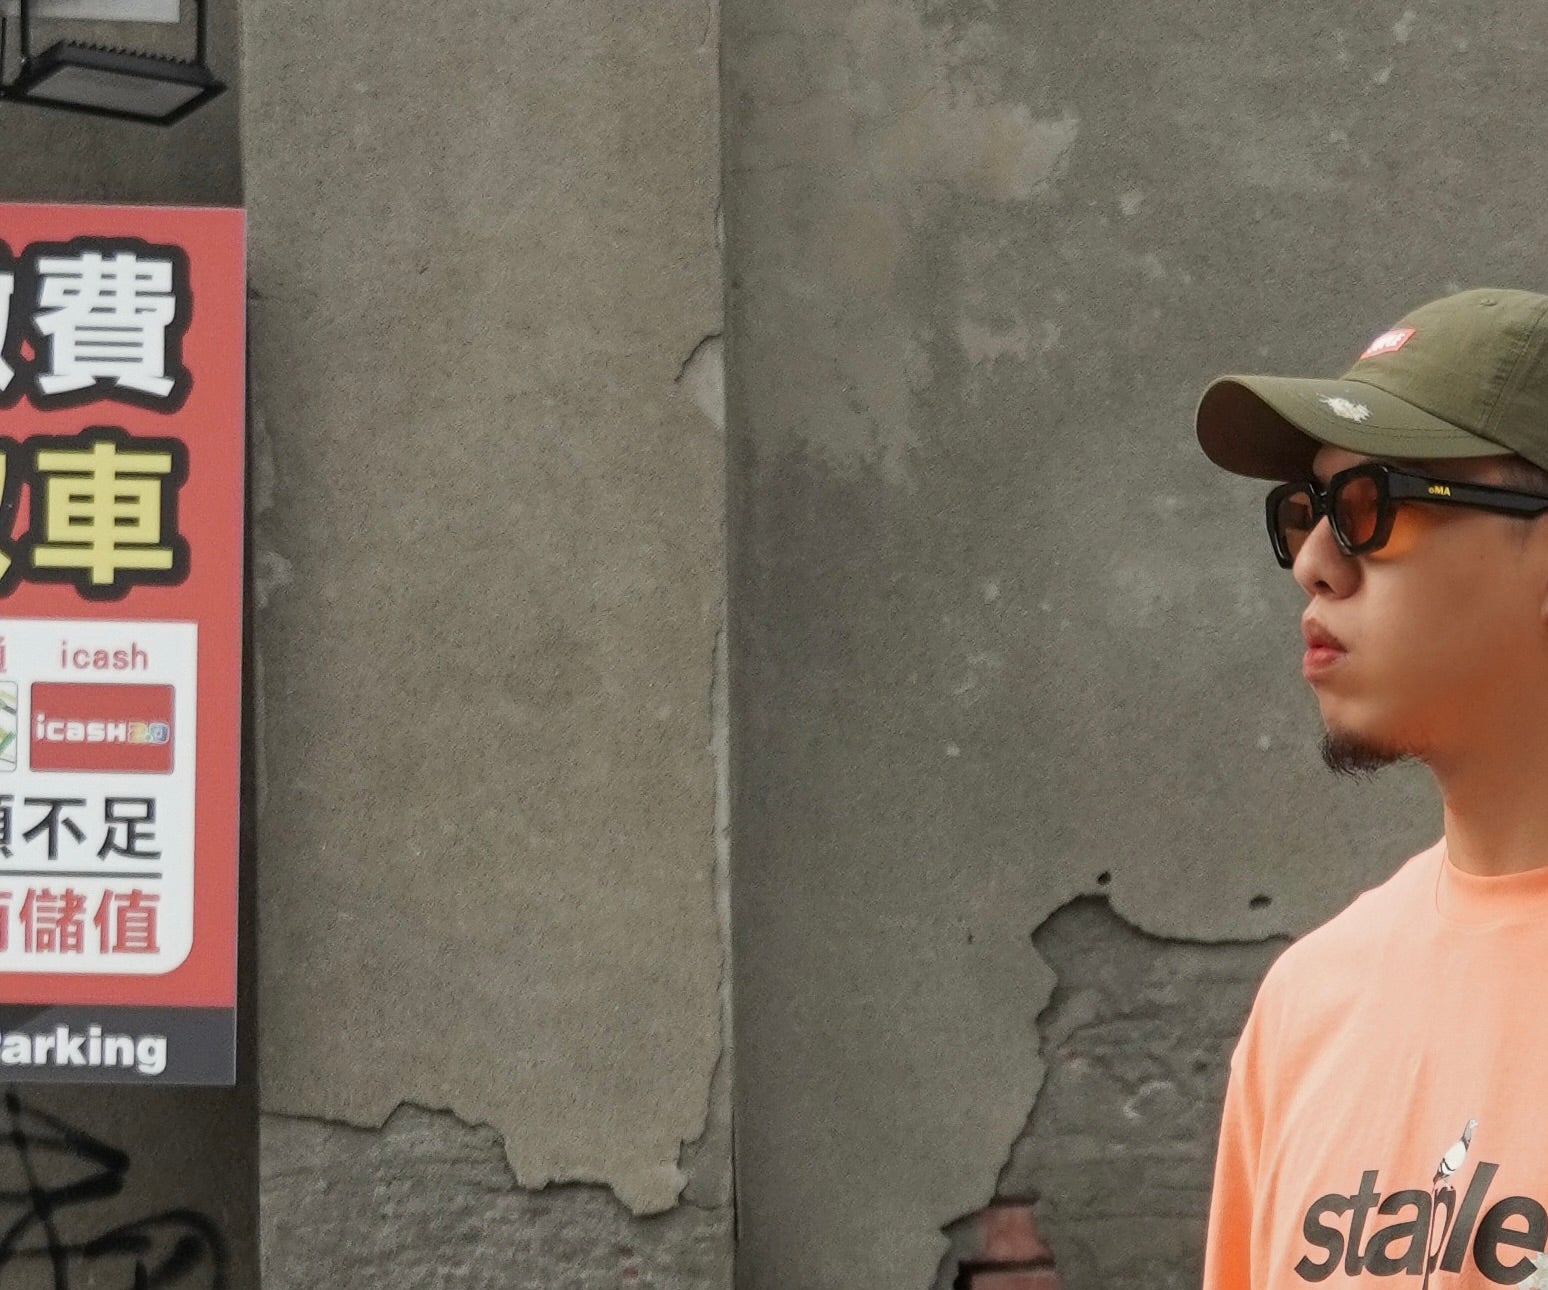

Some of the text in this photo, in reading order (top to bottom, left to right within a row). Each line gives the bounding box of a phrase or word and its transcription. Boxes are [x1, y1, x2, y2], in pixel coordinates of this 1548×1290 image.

[0, 252, 177, 398] 費
[0, 441, 175, 585] 車
[61, 640, 148, 671] icash
[0, 794, 162, 862] 不足
[0, 887, 161, 954] 儲值
[0, 1023, 168, 1076] arking
